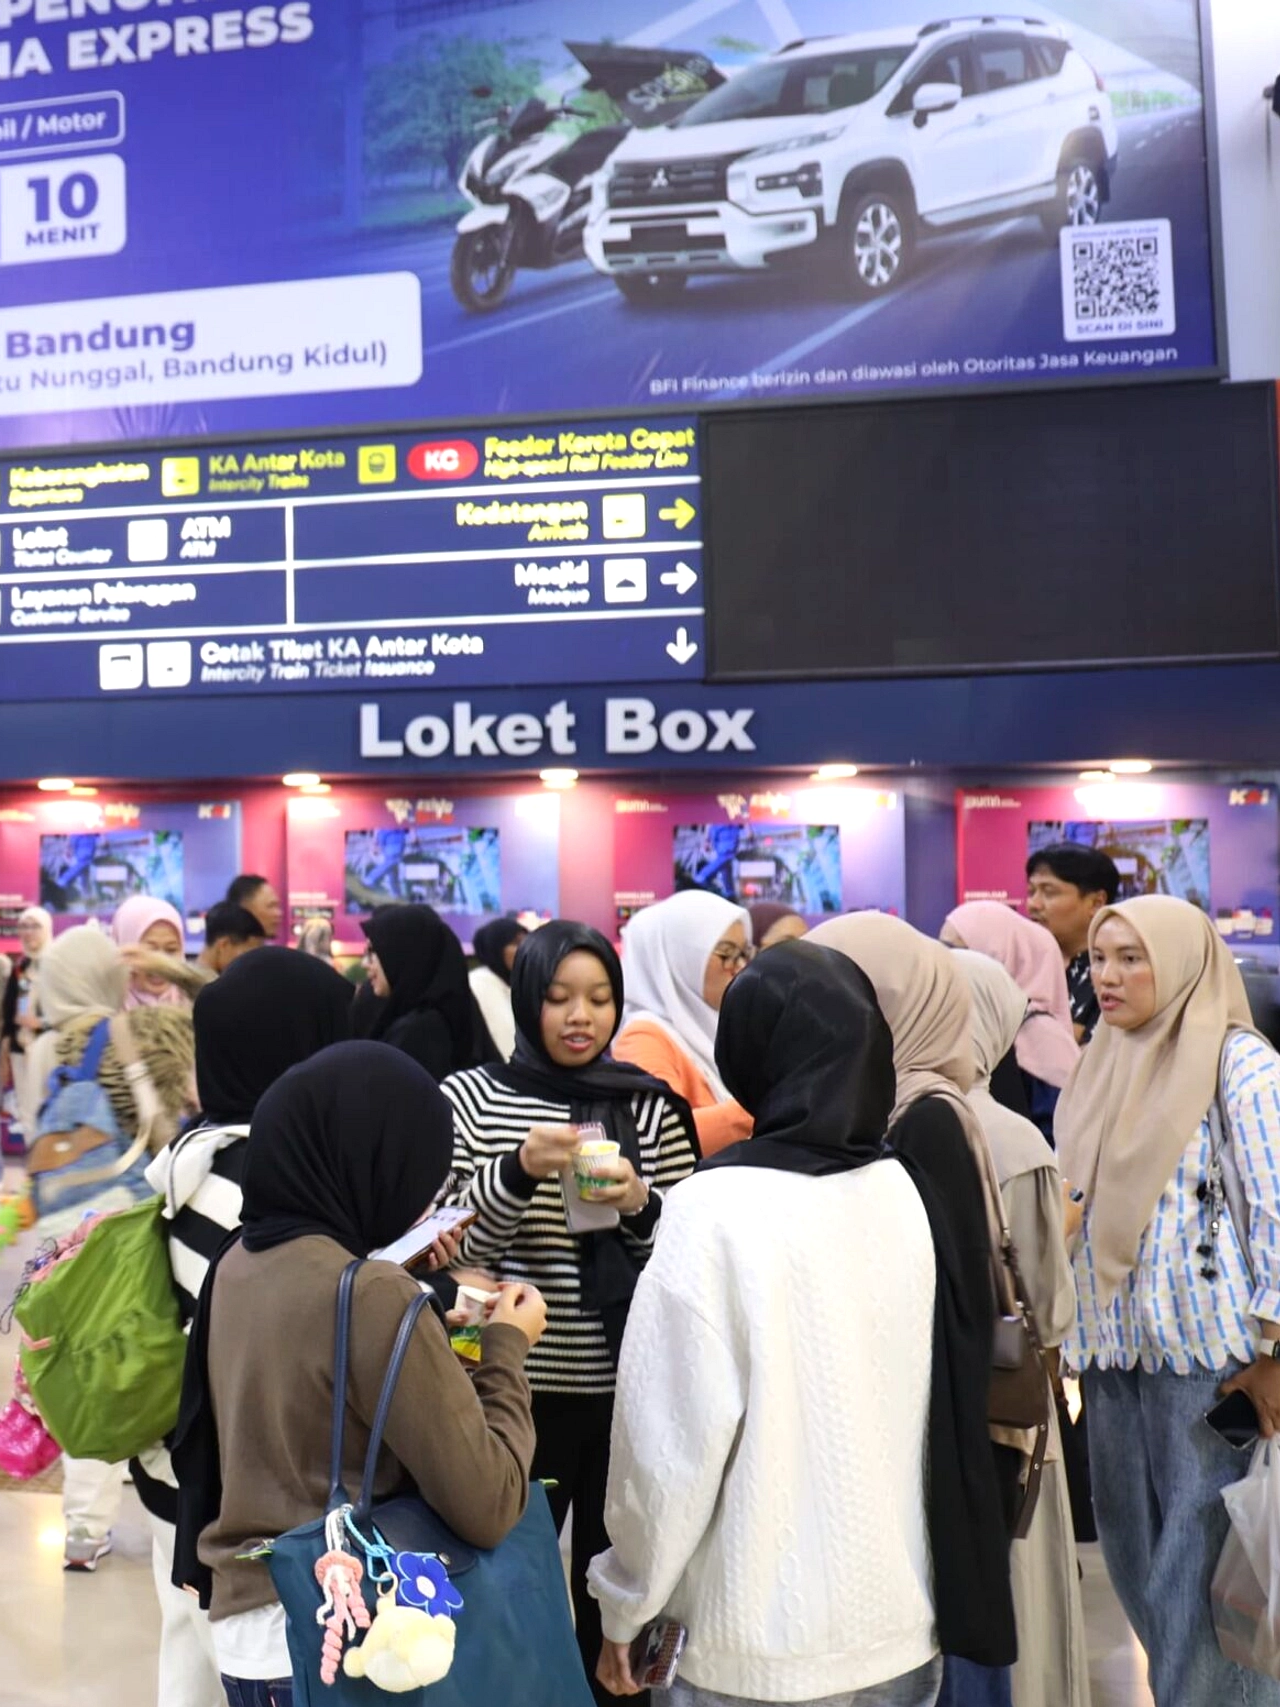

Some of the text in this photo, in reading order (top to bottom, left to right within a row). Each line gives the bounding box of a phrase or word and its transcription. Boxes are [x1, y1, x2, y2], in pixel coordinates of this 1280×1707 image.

[68, 2, 314, 70] EXPRESS
[36, 110, 107, 136] Motor
[27, 171, 99, 222] 10
[26, 223, 100, 247] MENIT
[5, 320, 196, 360] Bandung
[30, 360, 155, 392] Nunggal,
[163, 351, 295, 379] Bandung
[303, 339, 388, 369] Kidul)
[649, 378, 679, 396] BFI
[813, 366, 848, 384] dan
[920, 358, 960, 377] oleh
[963, 354, 1036, 375] Otoritas
[1038, 353, 1079, 370] Jasa
[1083, 347, 1178, 366] Keuangan
[209, 448, 347, 475] KA Antar Kota
[268, 638, 323, 662] Tiket
[326, 636, 362, 658] KA
[364, 633, 429, 657] Antar
[430, 632, 485, 655] Kota
[200, 664, 267, 684] Intercity
[313, 658, 362, 678] Ticket
[358, 697, 758, 758] Loket Box
